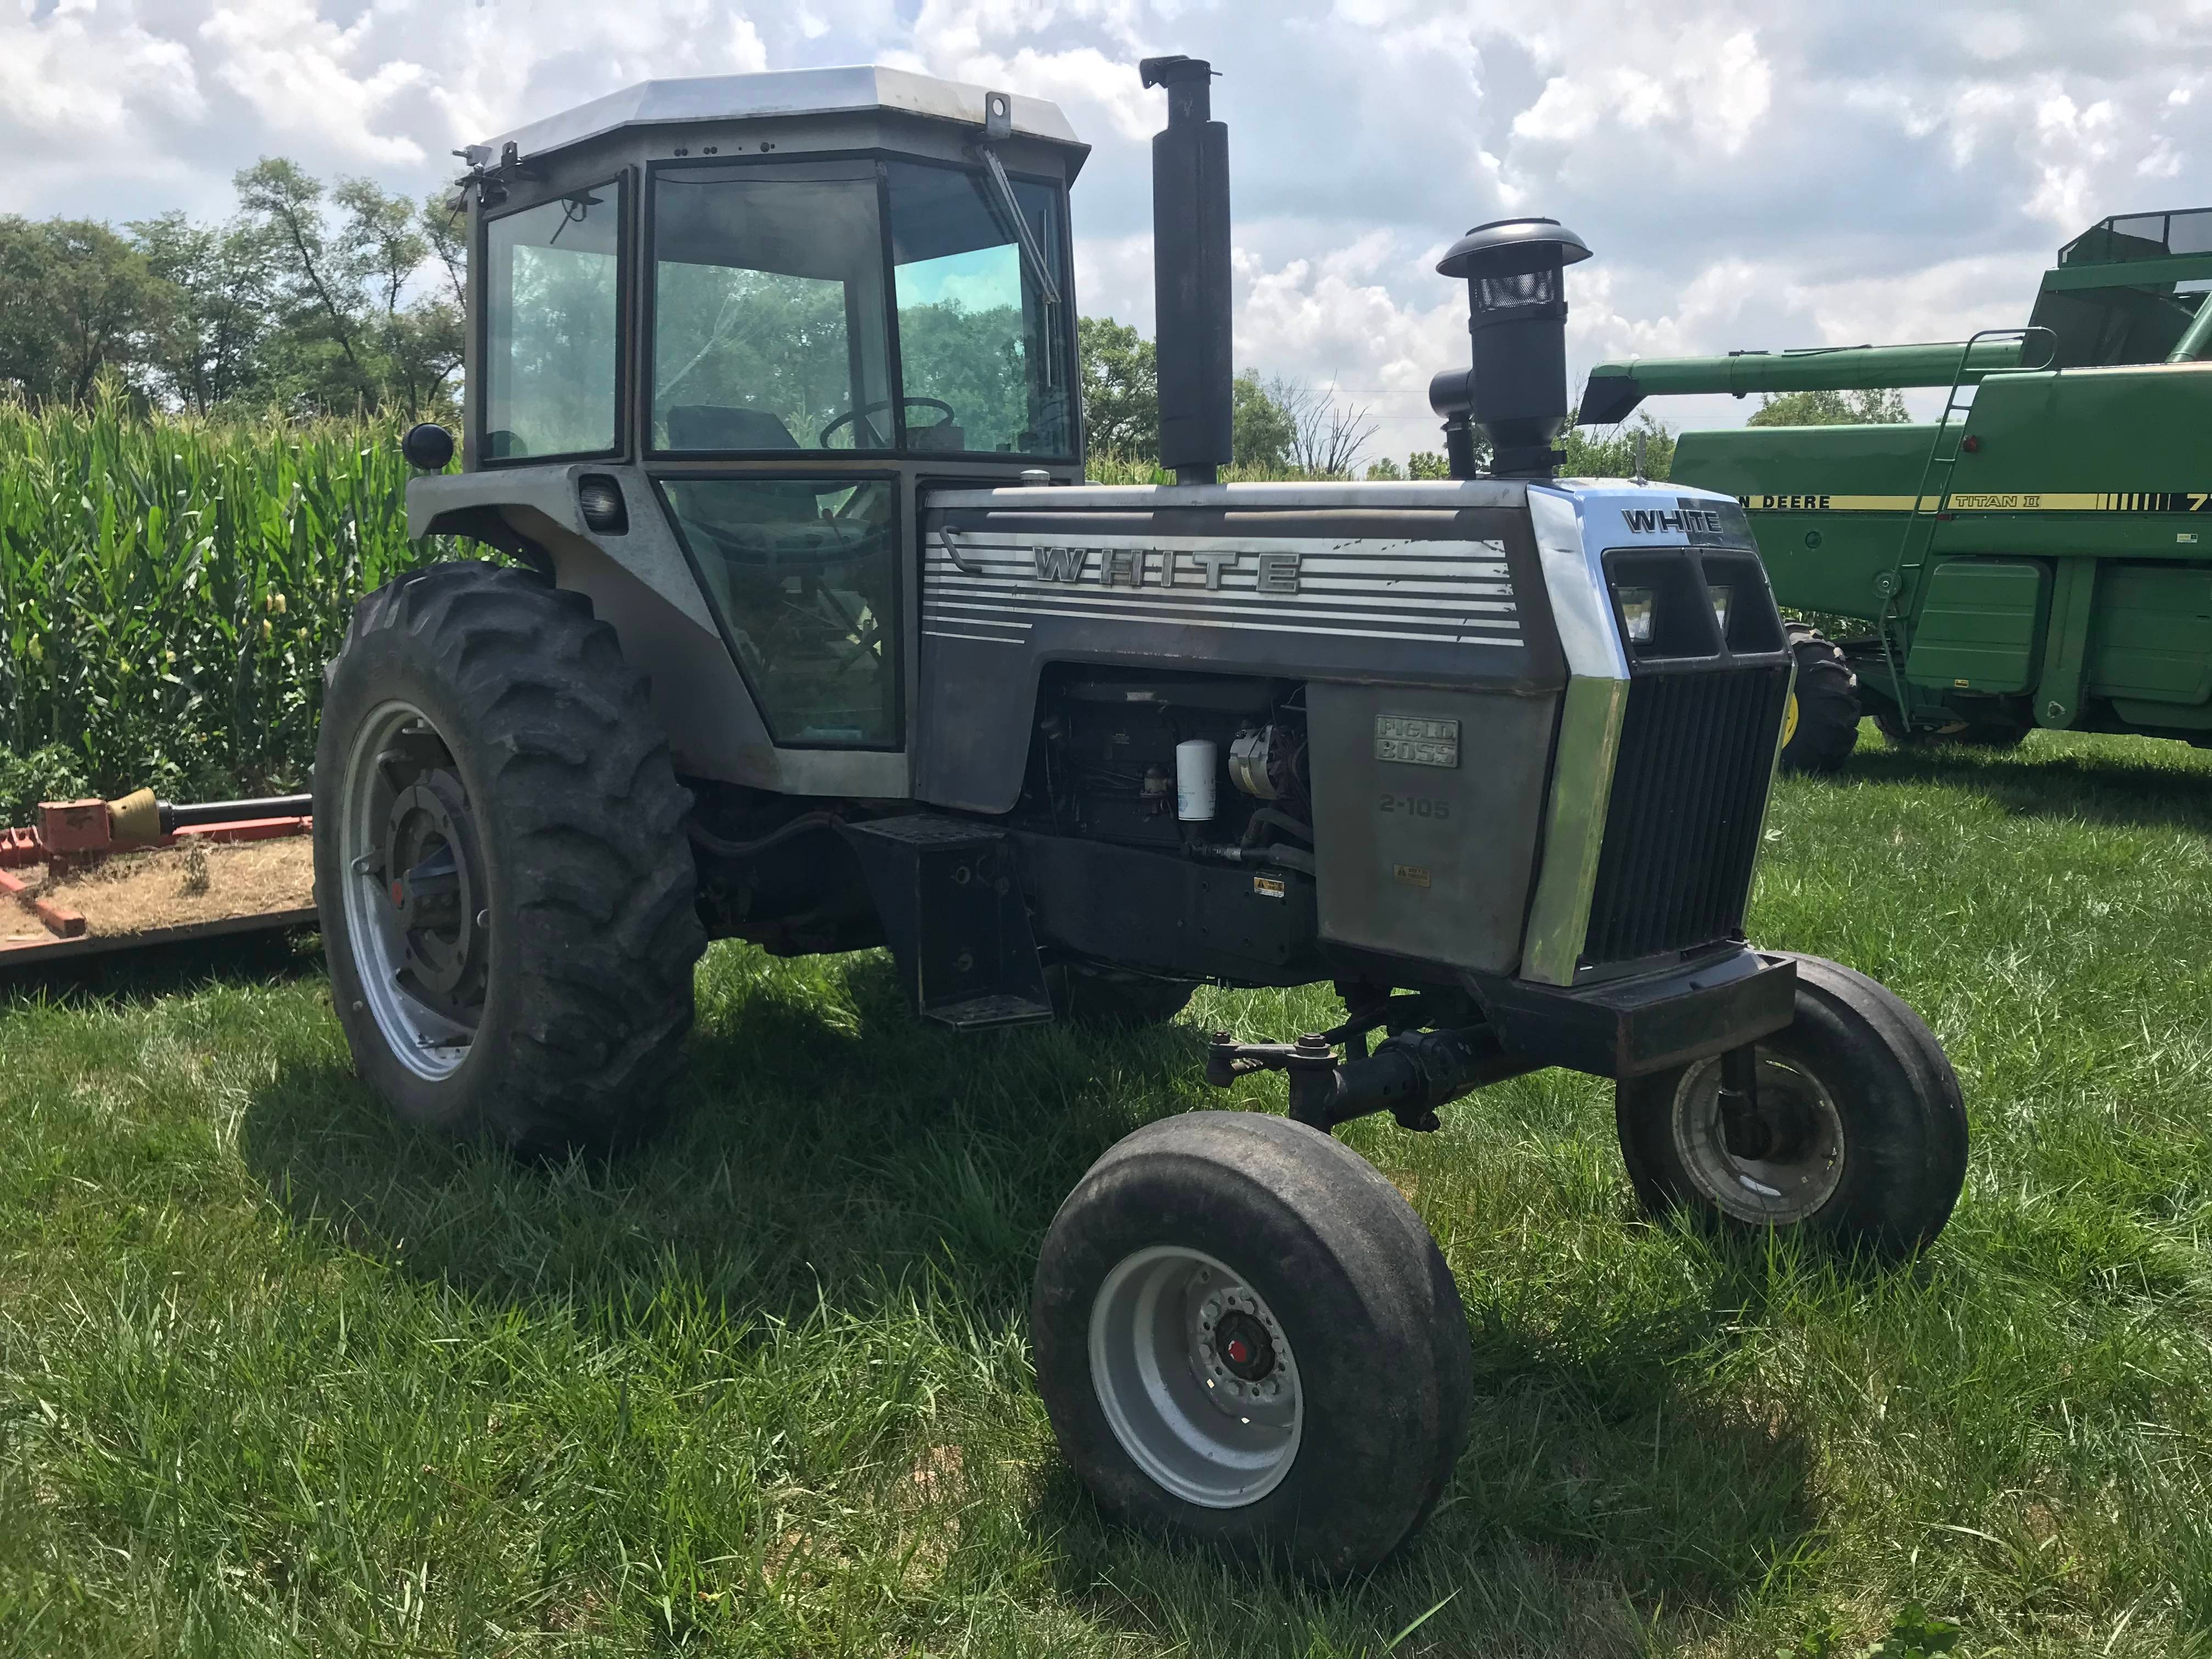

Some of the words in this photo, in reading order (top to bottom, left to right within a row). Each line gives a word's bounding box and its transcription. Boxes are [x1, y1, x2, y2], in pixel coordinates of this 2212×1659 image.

[1763, 495, 1830, 509] DEERE
[1955, 495, 2018, 507] TITAN
[2023, 495, 2040, 507] II
[2186, 493, 2212, 511] 7
[1621, 508, 1724, 534] WHITE
[1032, 546, 1301, 594] WHITE
[1377, 740, 1454, 764] BOSS
[1379, 794, 1450, 820] 2-105
